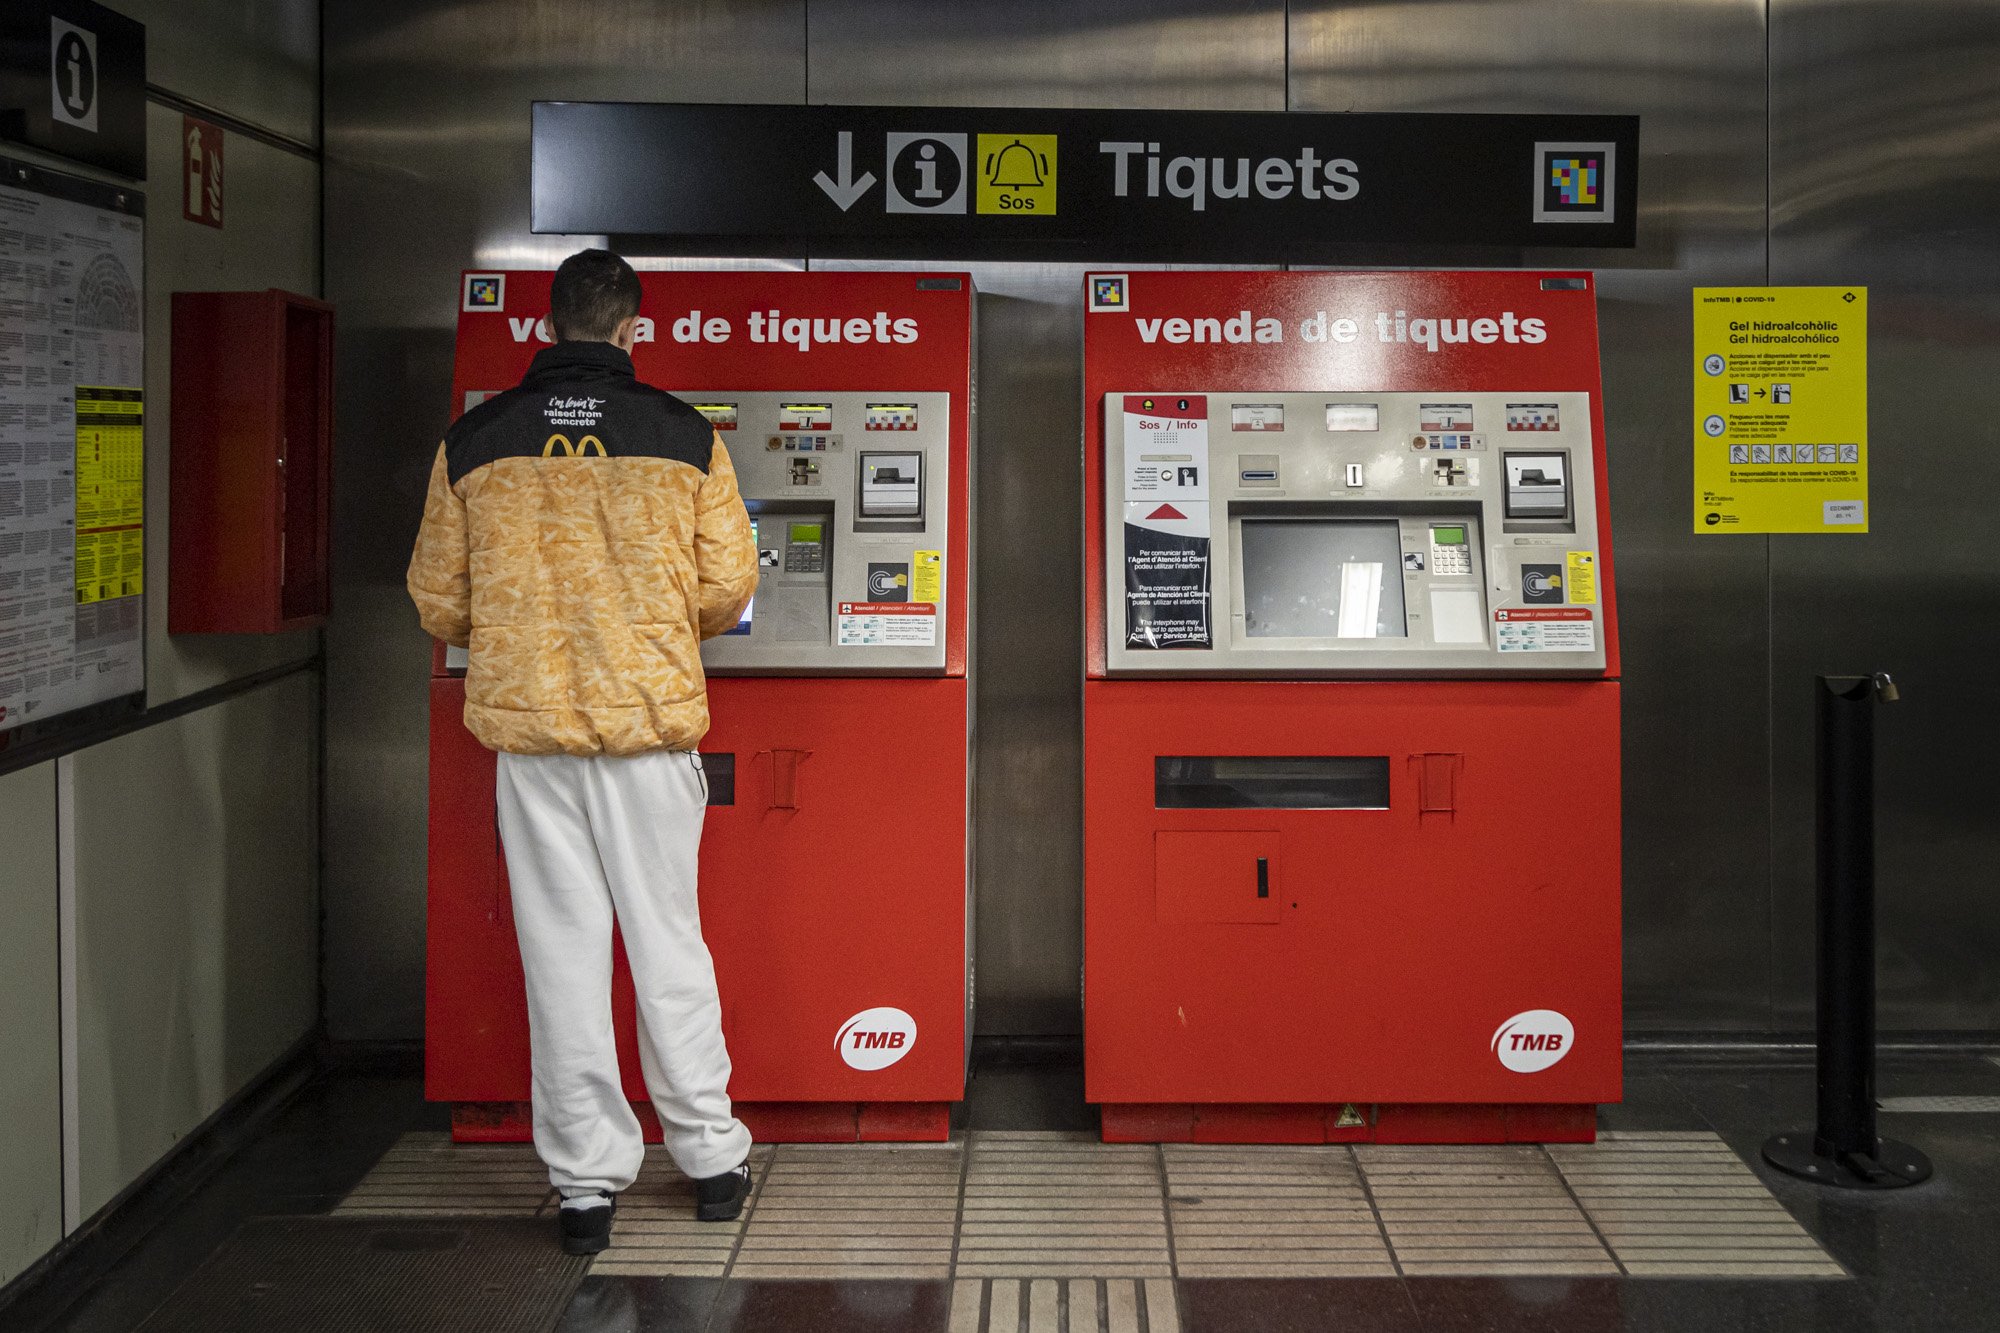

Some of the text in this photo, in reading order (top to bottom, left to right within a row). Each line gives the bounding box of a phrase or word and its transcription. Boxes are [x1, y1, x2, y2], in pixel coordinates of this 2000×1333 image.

[1099, 141, 1360, 211] Tiquets
[999, 194, 1035, 210] Sos
[672, 309, 732, 343] de
[747, 309, 919, 352] tiquets
[1135, 310, 1547, 352] venda de tiquets
[1729, 320, 1838, 331] Gel hidroalcohòlic
[1729, 333, 1840, 344] Gel hidroalcohólico
[544, 409, 602, 418] raised from
[551, 418, 596, 426] concrete
[1139, 420, 1160, 430] Sos
[1176, 420, 1198, 430] Info
[852, 1031, 906, 1049] TMB
[1510, 1034, 1563, 1051] TMB
